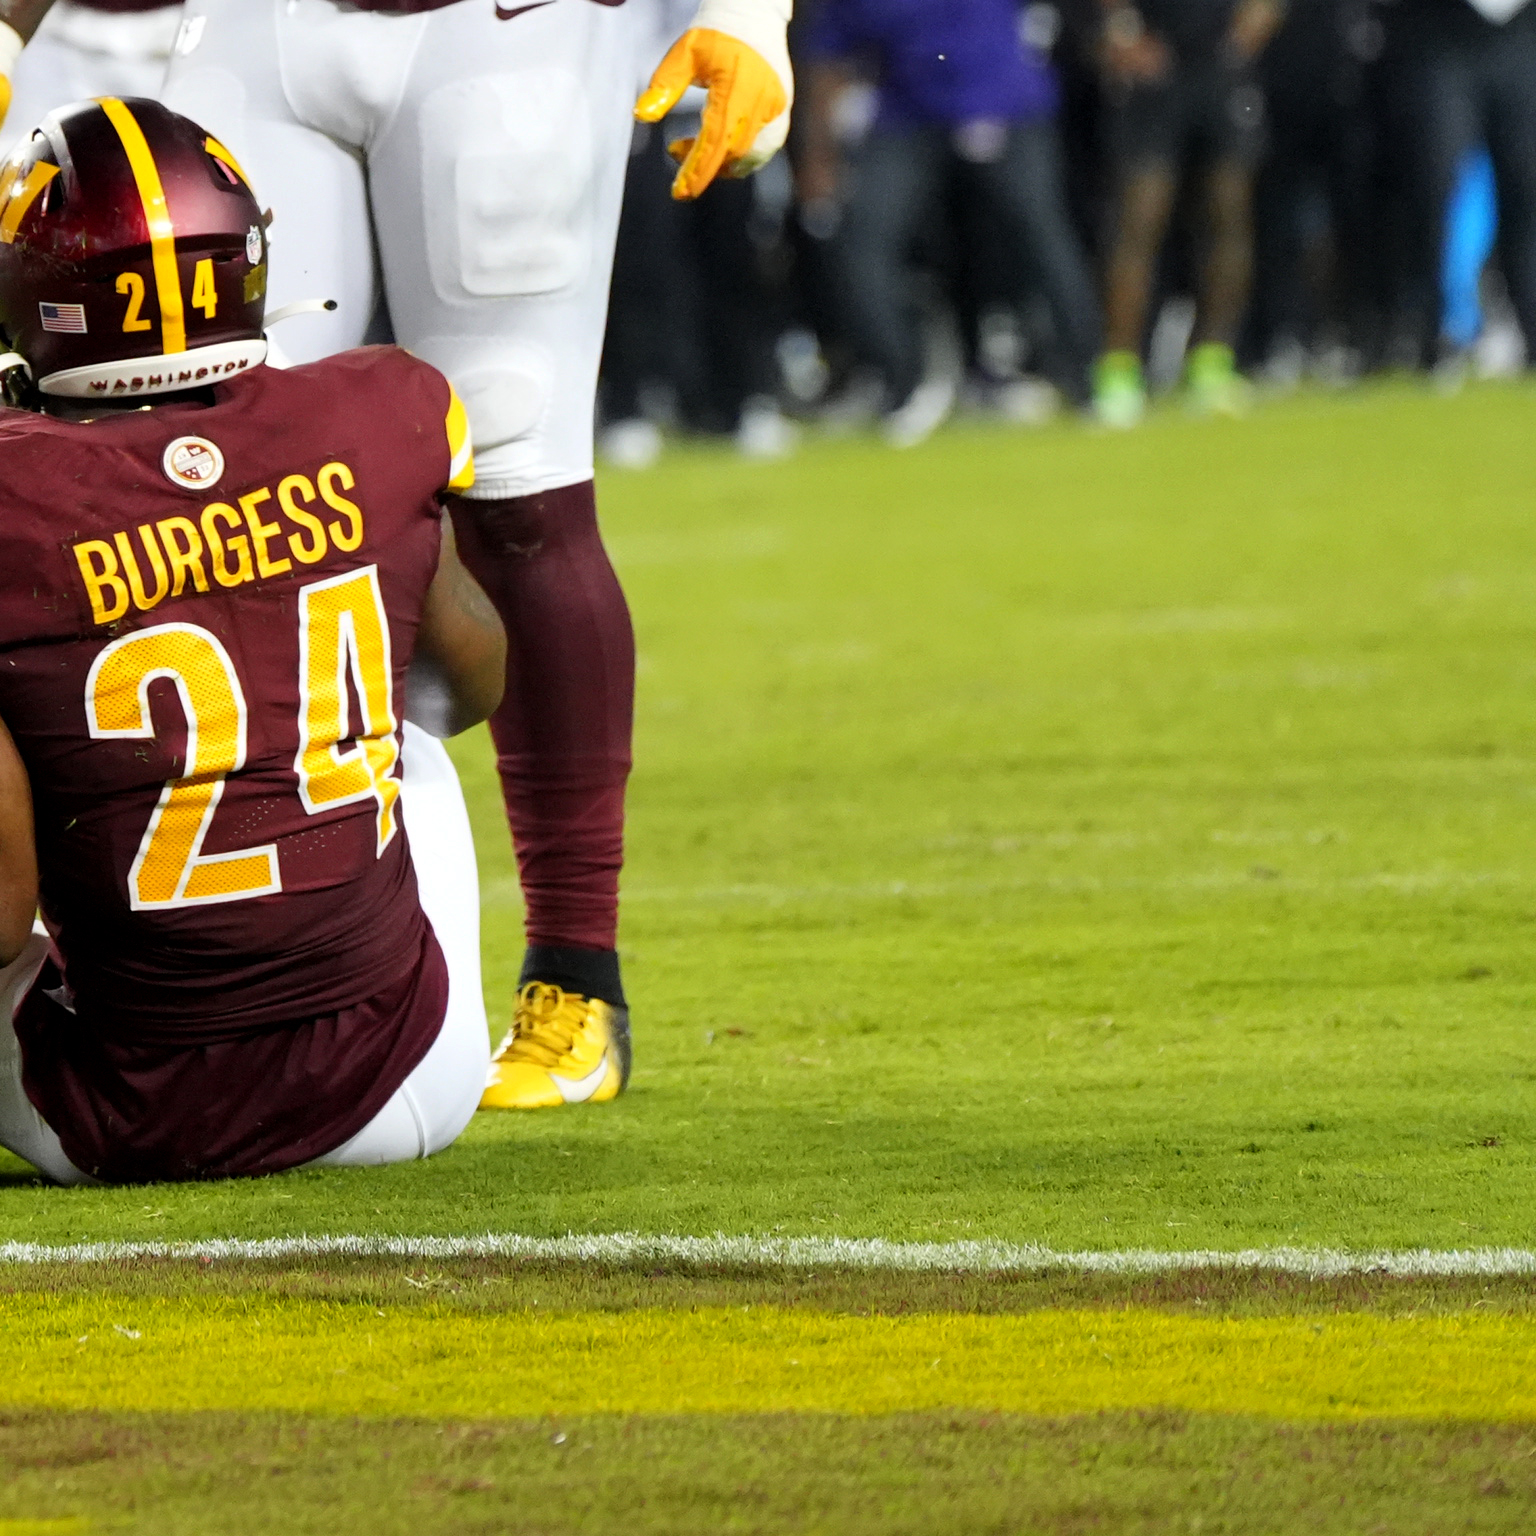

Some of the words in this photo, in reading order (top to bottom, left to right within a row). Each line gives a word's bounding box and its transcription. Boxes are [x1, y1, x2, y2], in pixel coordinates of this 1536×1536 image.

[88, 357, 249, 393] WASHINGTON
[72, 460, 365, 626] BURGESS
[84, 563, 402, 912] 24
